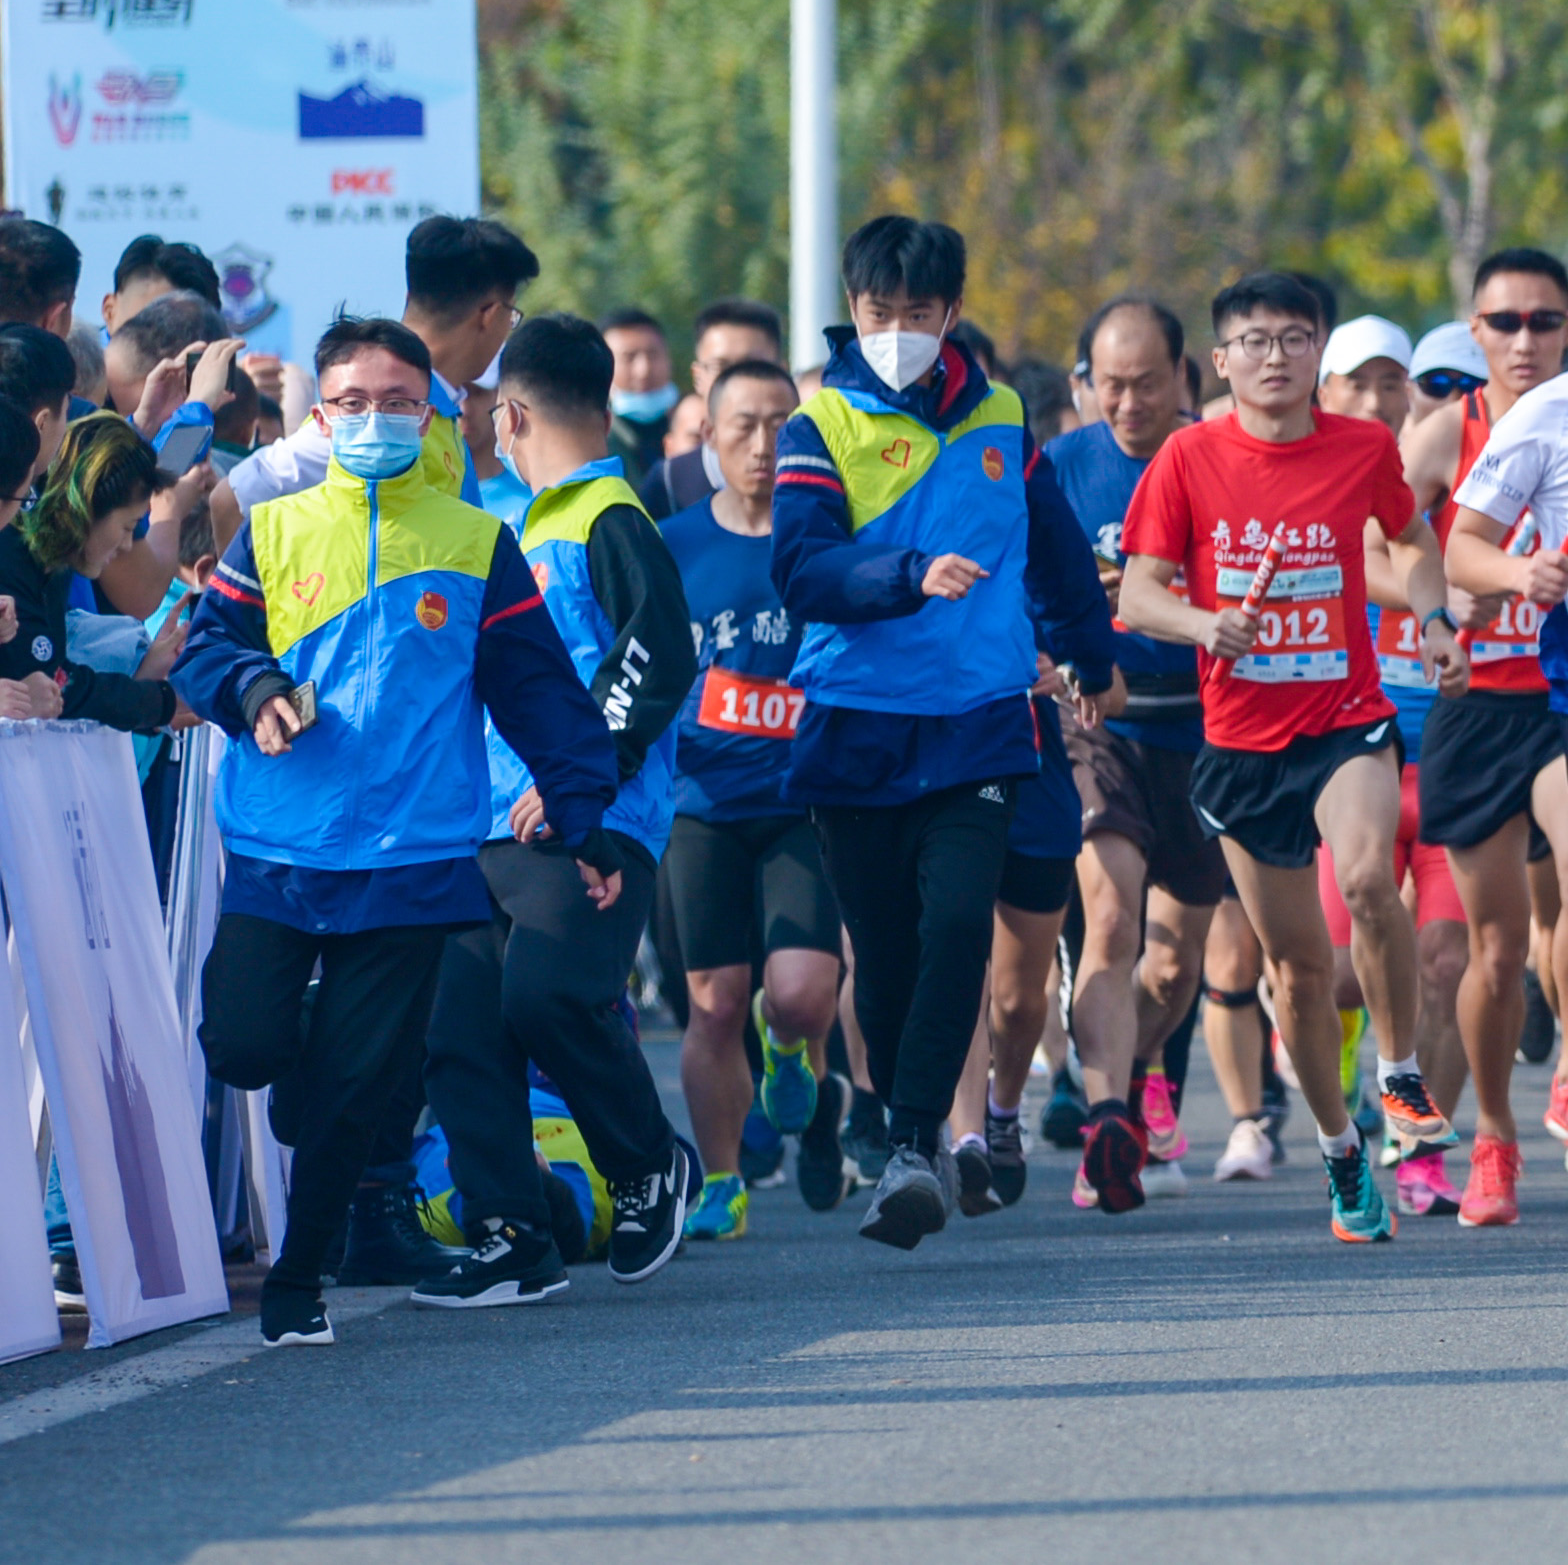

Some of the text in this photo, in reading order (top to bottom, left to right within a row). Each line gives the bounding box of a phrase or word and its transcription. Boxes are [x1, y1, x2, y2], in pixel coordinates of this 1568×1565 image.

[1214, 550, 1335, 565] Qingda ongpao
[1252, 608, 1330, 647] 012
[1494, 600, 1538, 636] 10
[720, 686, 807, 730] 1107
